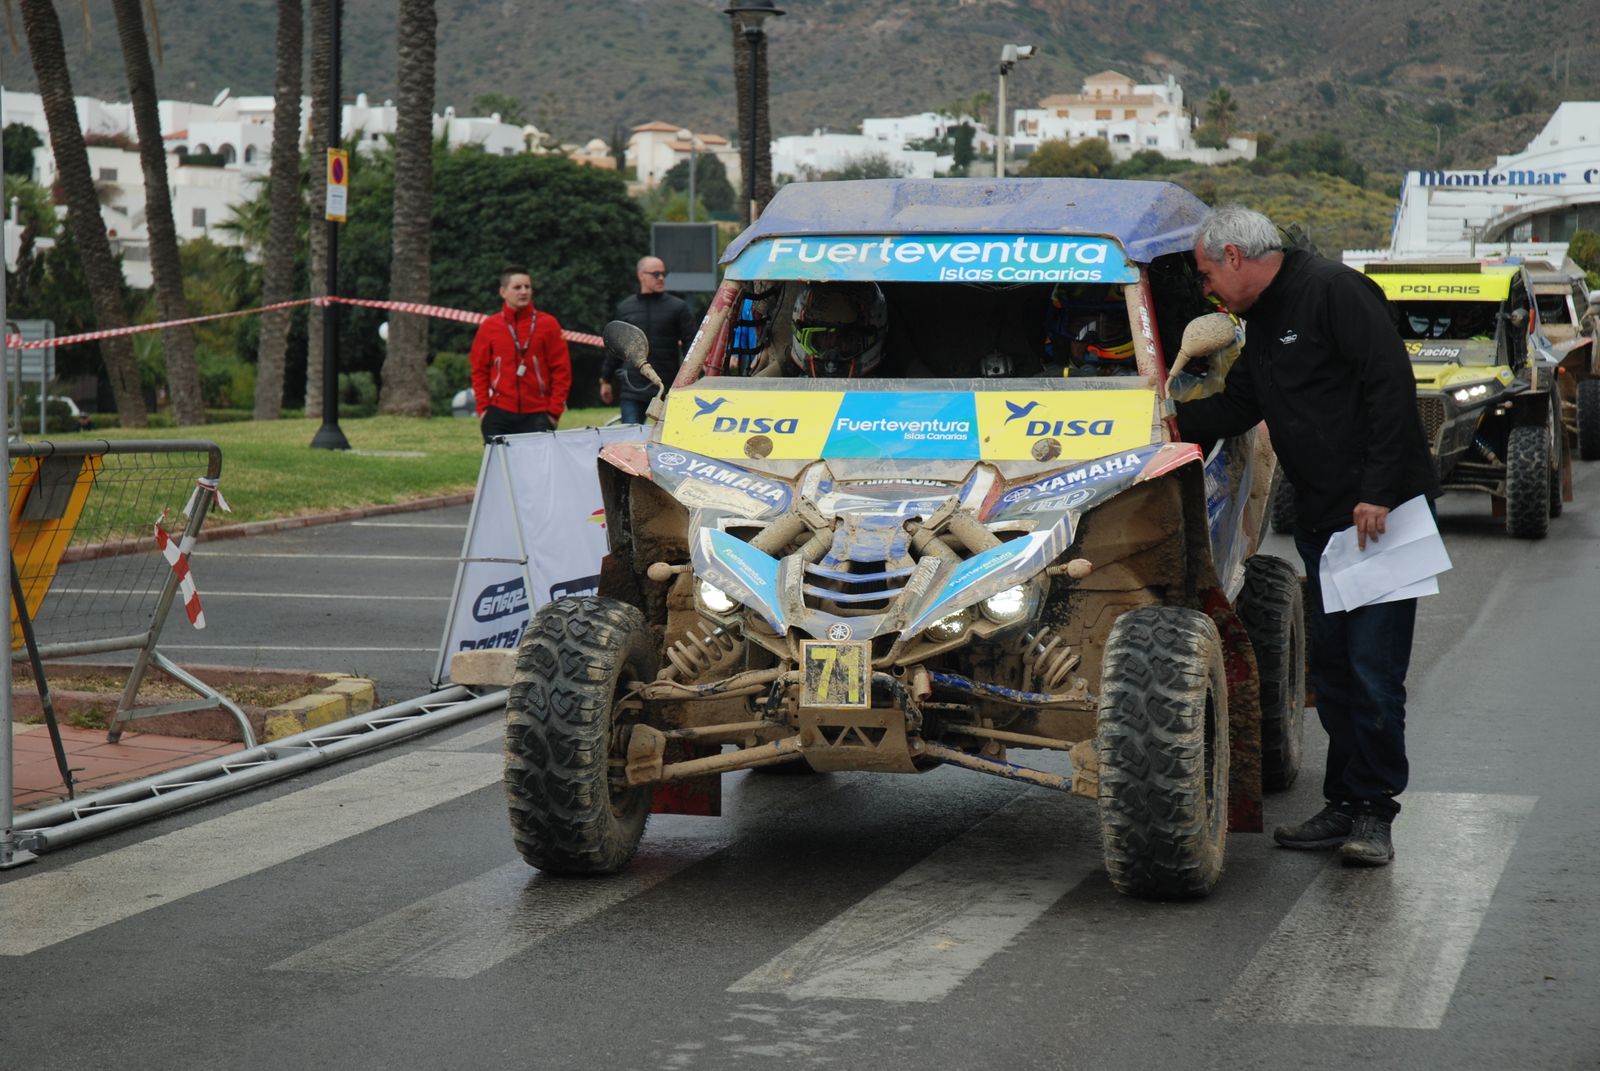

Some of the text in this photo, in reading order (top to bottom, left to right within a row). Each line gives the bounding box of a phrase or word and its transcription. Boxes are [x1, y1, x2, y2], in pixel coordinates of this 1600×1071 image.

[1419, 169, 1567, 186] MonteMar
[767, 236, 1108, 264] Fuerteventura
[939, 266, 1102, 282] Islas Canarias
[1400, 285, 1481, 294] POLARIS
[836, 417, 970, 432] Fuerteventura
[904, 432, 968, 441] Islas Canarias
[686, 459, 785, 501] YAMAHA
[1033, 453, 1142, 493] YAMAHA
[810, 646, 860, 703] 71
